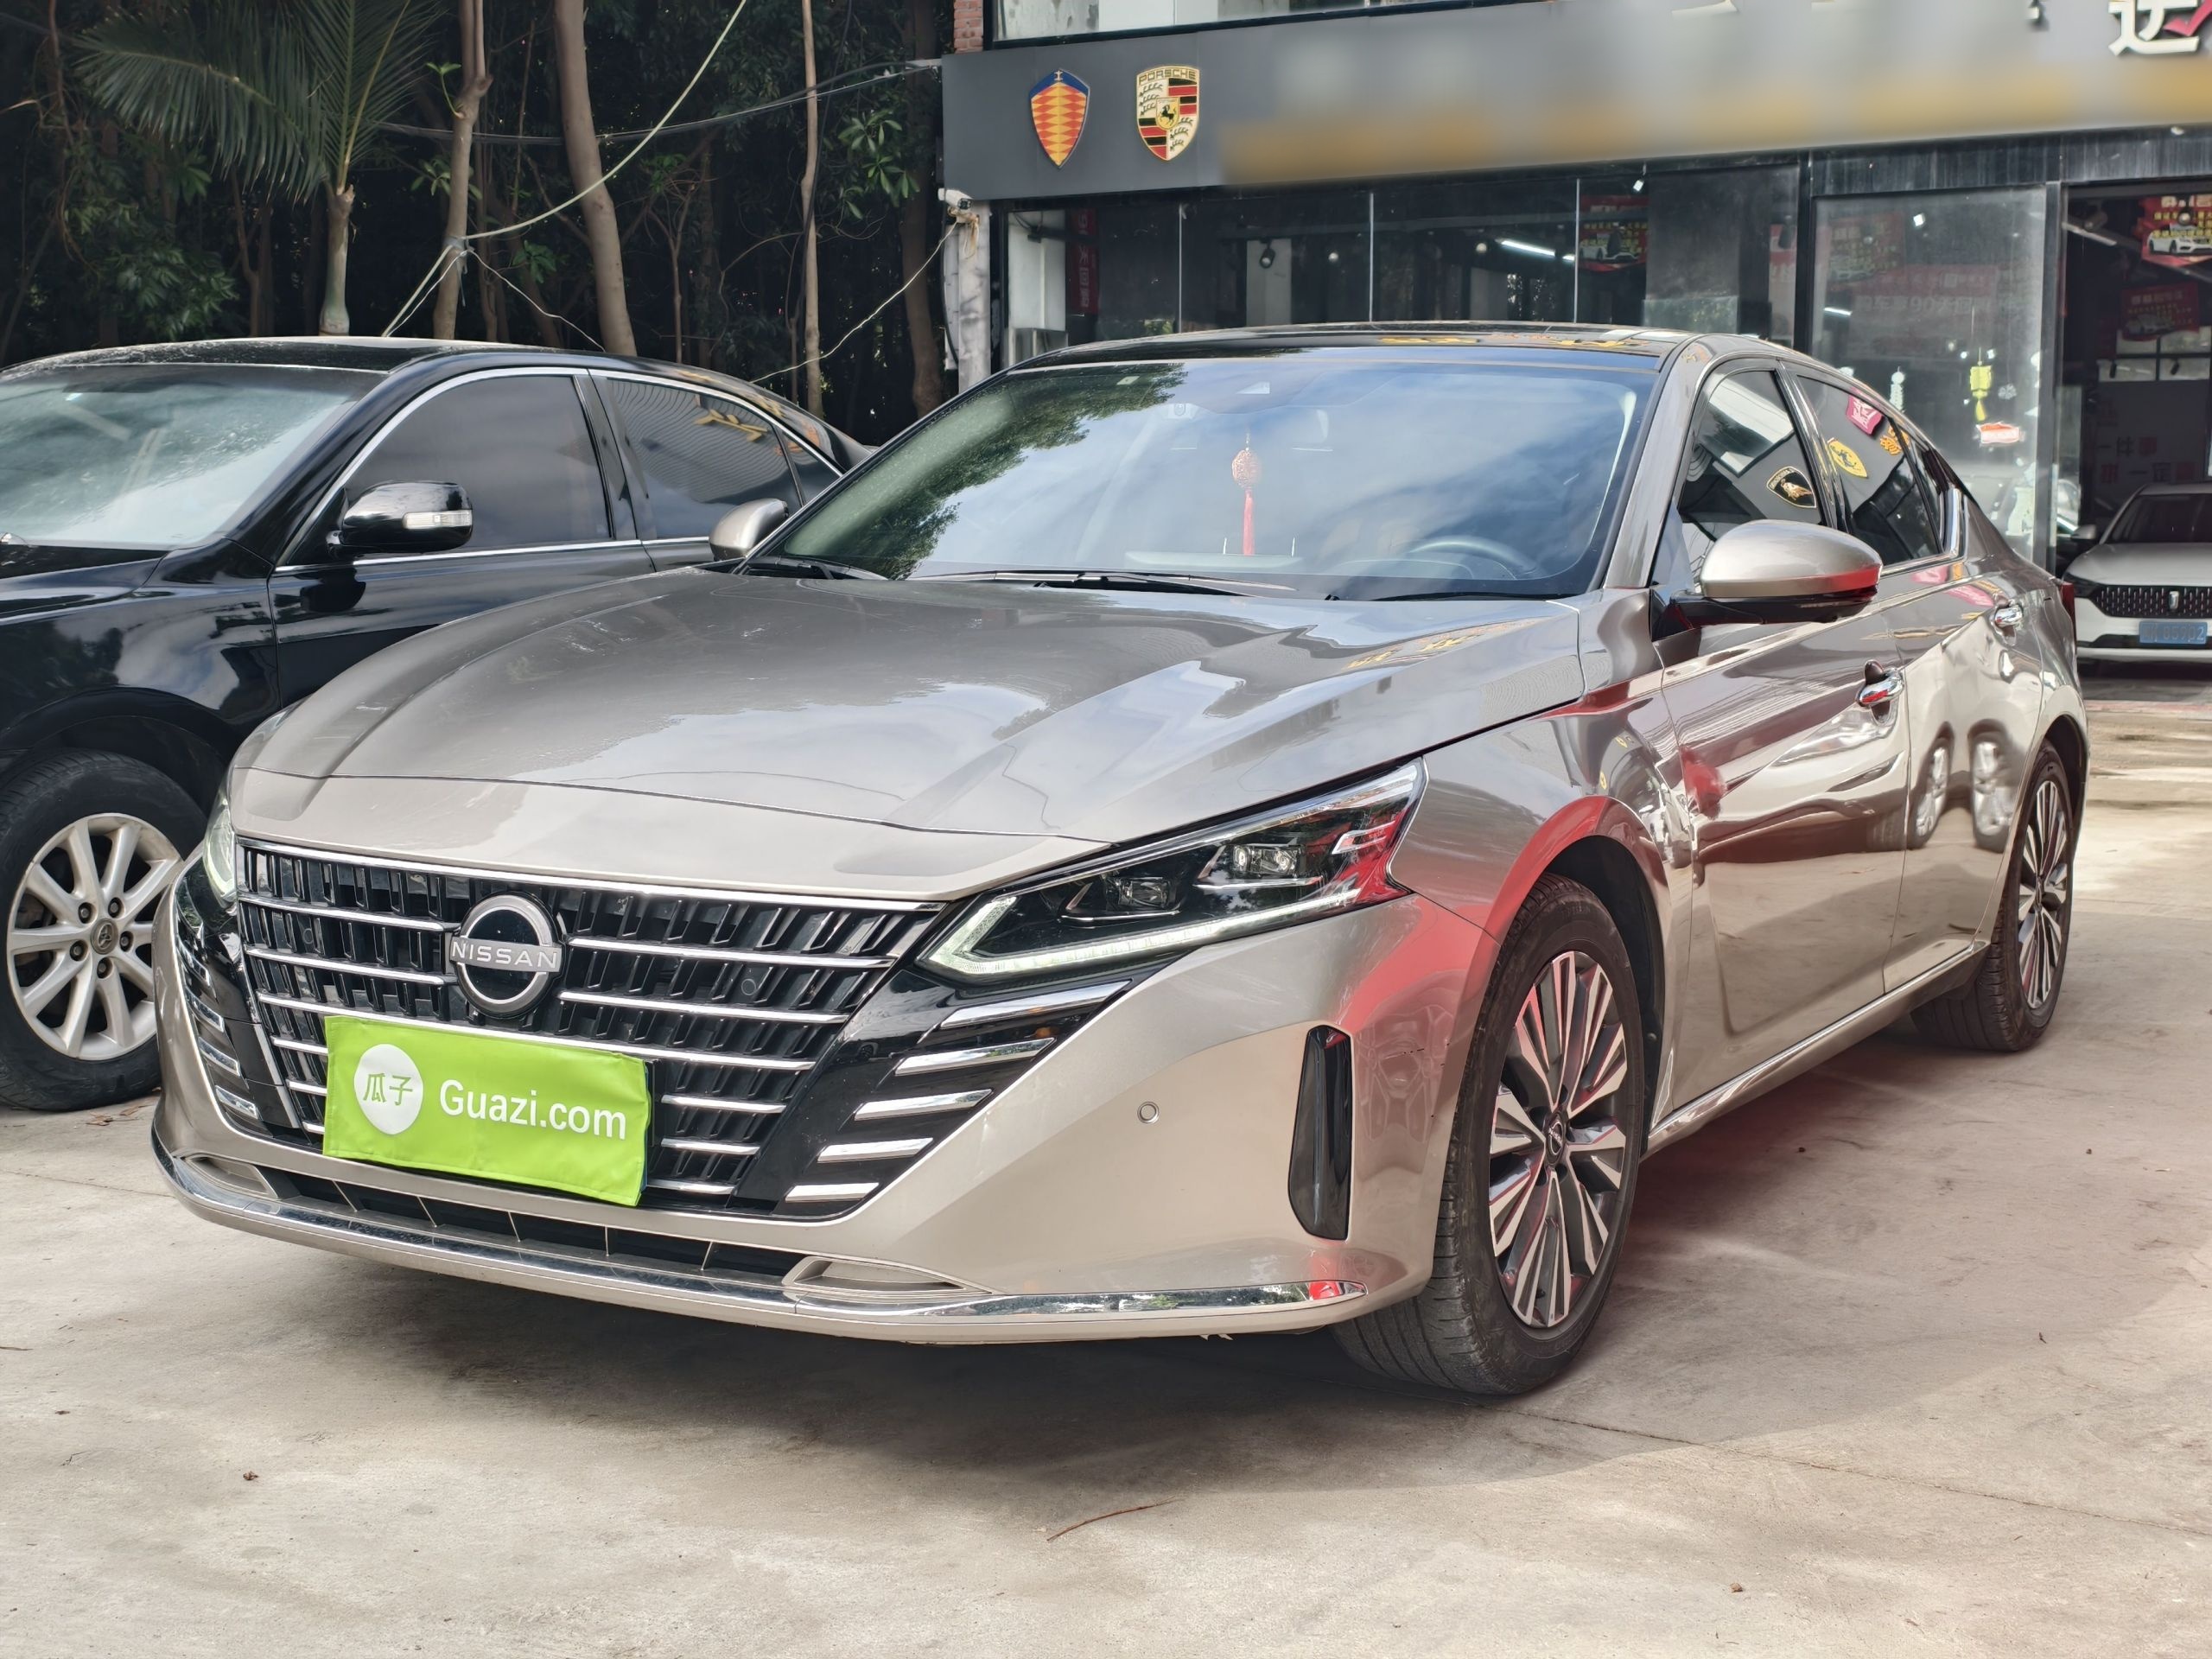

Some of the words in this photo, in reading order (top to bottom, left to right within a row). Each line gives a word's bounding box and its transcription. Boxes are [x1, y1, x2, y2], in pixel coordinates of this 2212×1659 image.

[1139, 68, 1197, 86] PORSCHE
[451, 941, 558, 969] NISSAN
[363, 1072, 413, 1106] 瓜子
[439, 1079, 626, 1140] Guazi.com
